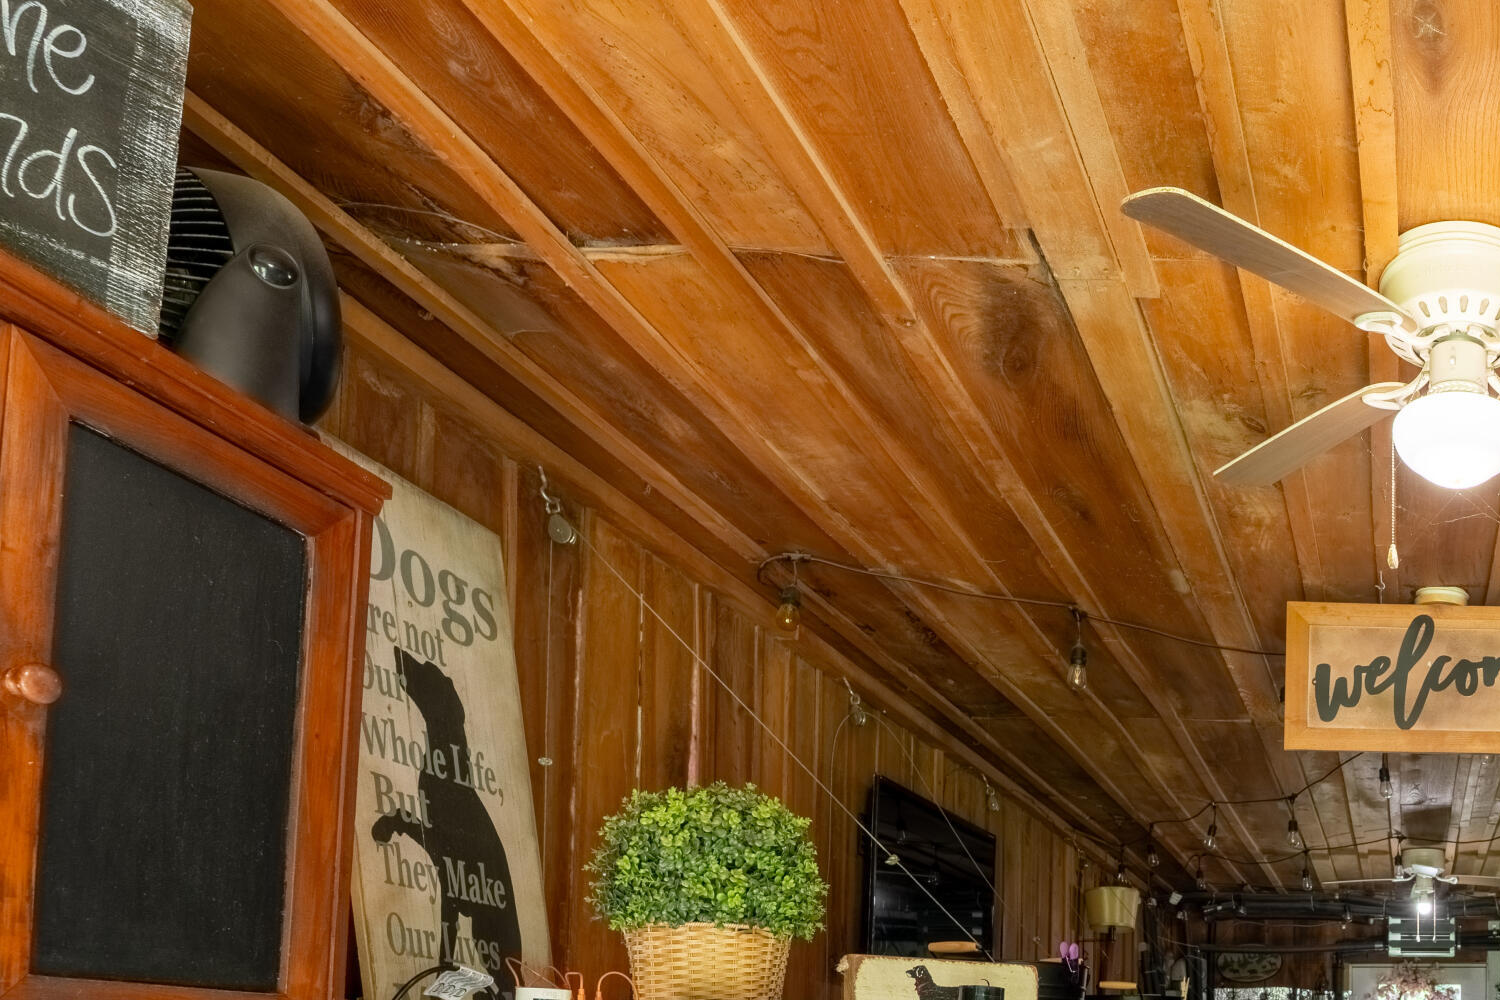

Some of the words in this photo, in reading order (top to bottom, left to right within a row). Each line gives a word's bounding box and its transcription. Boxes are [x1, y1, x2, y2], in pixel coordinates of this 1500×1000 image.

[366, 602, 398, 643] re
[403, 619, 447, 668] not
[361, 711, 448, 780] Whole
[450, 743, 504, 806] Life,
[370, 770, 432, 829] But
[376, 841, 440, 905] They
[442, 856, 507, 910] Make
[386, 911, 436, 960] Our
[441, 921, 501, 971] Lives
